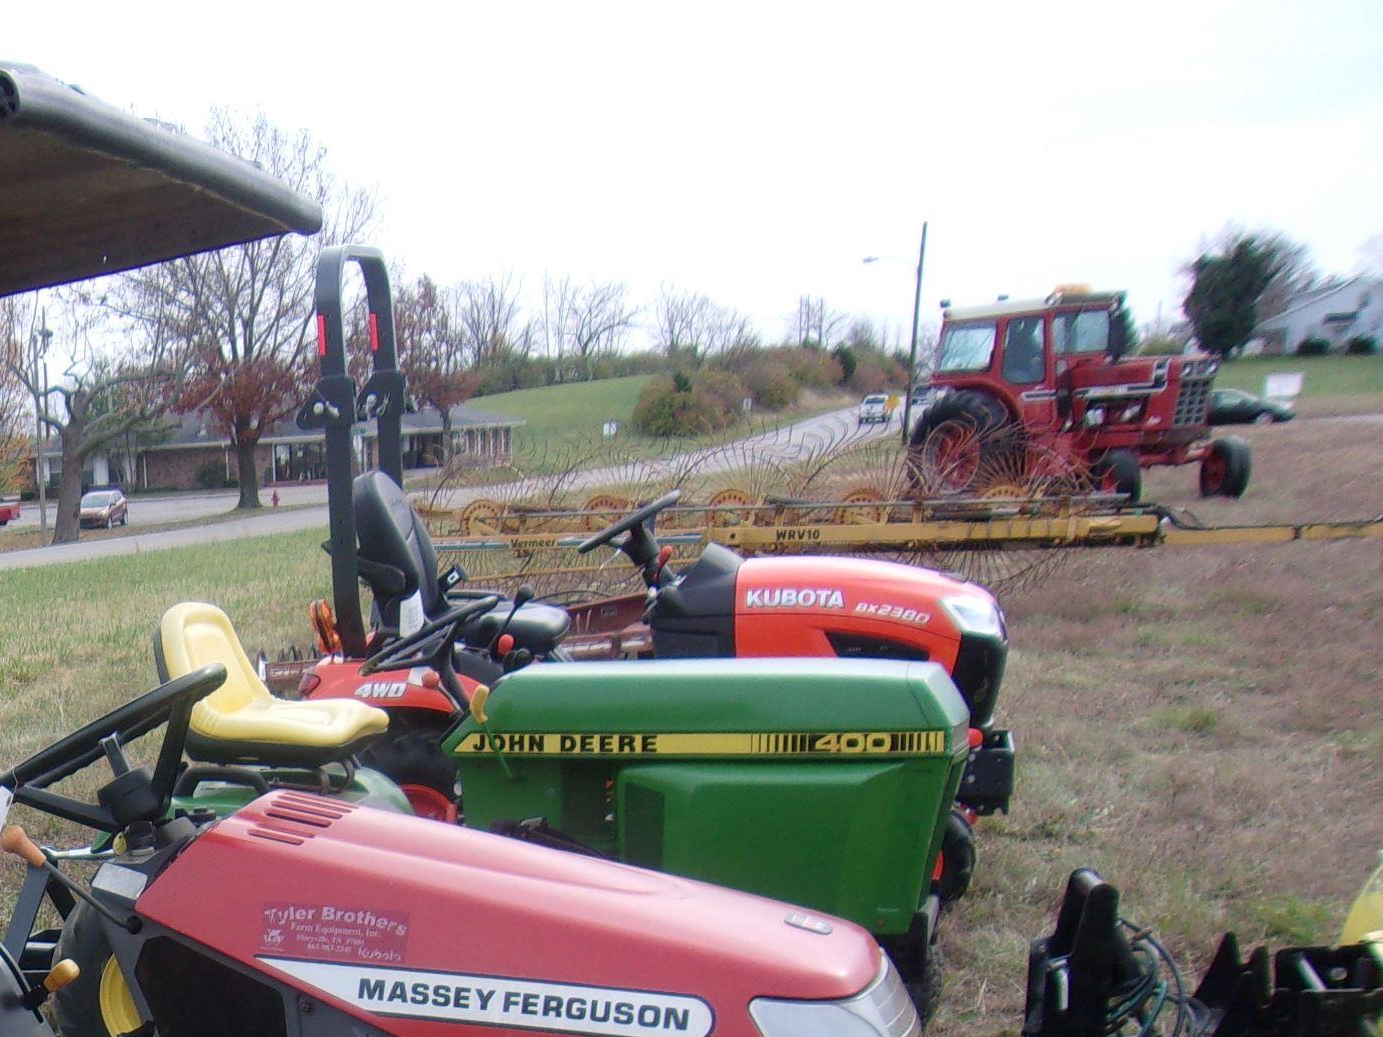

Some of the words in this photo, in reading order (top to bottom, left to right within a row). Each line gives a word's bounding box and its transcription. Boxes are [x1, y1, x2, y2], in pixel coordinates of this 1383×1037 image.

[510, 538, 556, 549] Vermeer
[776, 529, 820, 540] WRV10
[746, 588, 846, 609] KUBOTA
[856, 602, 931, 624] BX2380
[353, 682, 408, 698] 4WD
[473, 734, 545, 752] JOHN
[560, 734, 658, 753] DEERE
[815, 732, 892, 753] 400
[264, 906, 316, 925] Tyler
[321, 906, 408, 936] Brothers
[290, 922, 314, 932] Farm
[315, 924, 363, 938] Equipment,
[365, 928, 382, 938] Inc.
[358, 947, 402, 962] Kubota
[357, 978, 497, 1012] MASSEY
[502, 991, 690, 1031] FERGUSON
